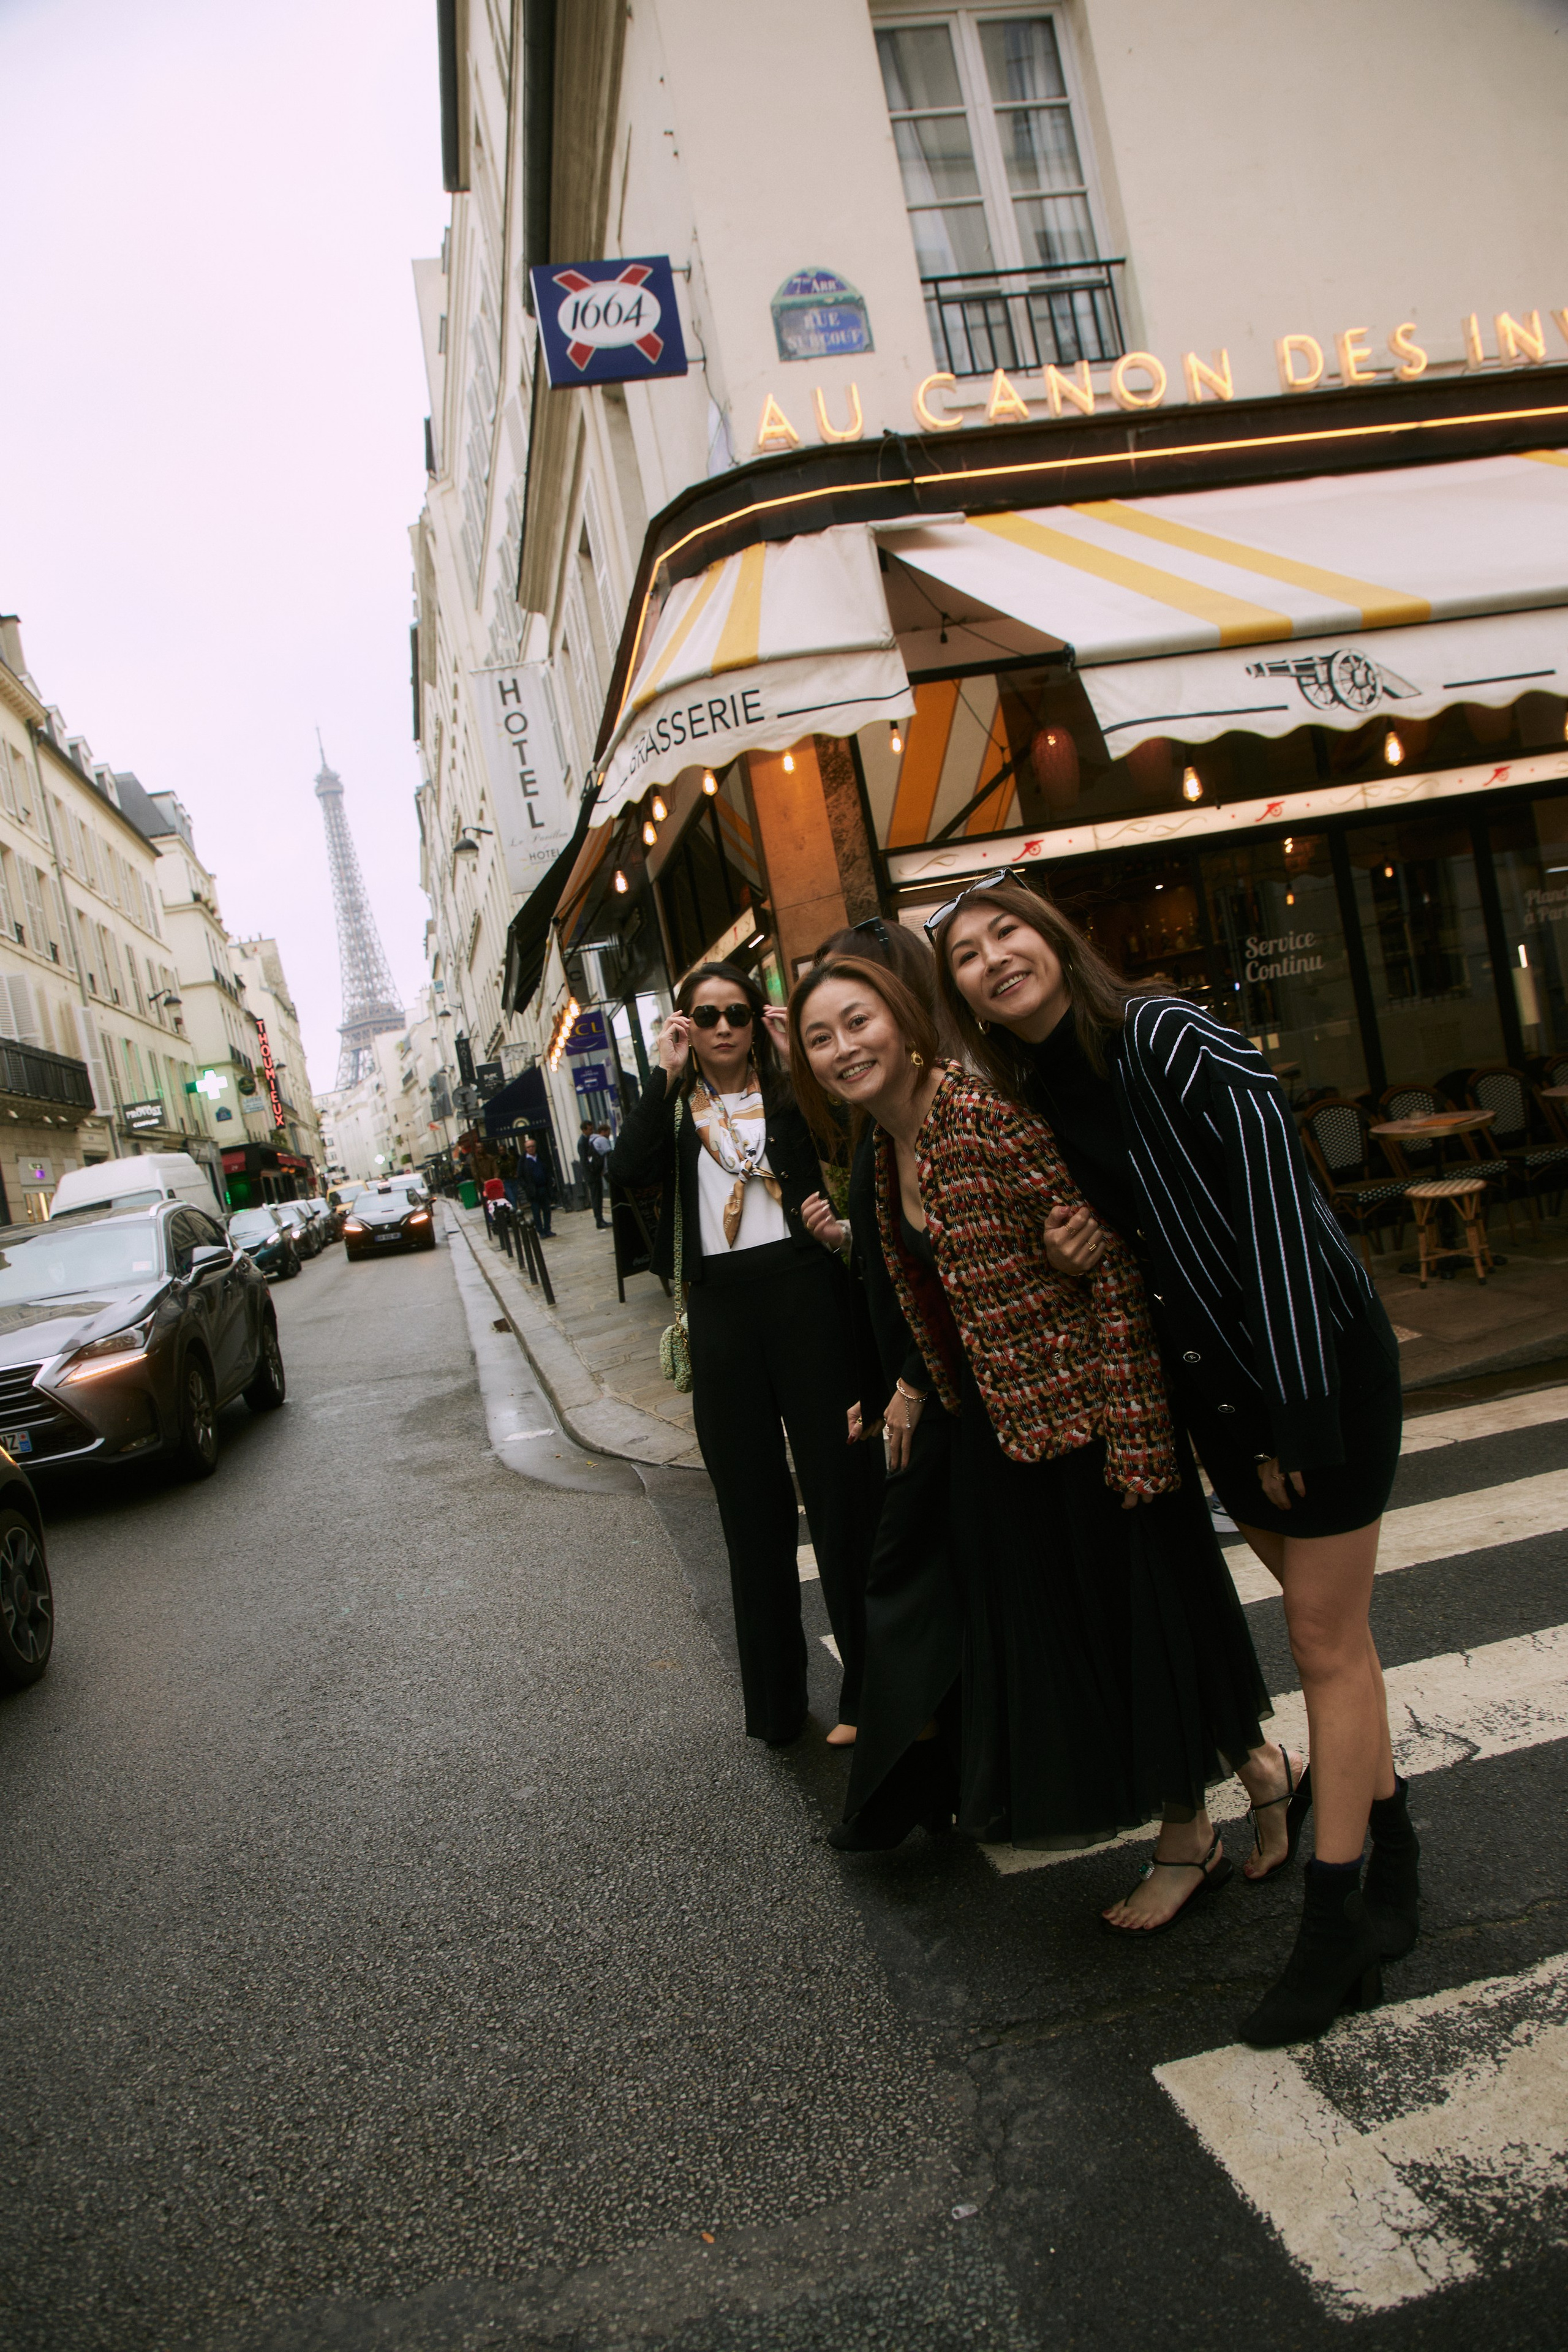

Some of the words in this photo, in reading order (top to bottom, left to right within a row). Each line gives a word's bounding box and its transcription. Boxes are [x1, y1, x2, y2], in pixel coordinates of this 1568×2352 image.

[570, 292, 650, 333] 1664
[804, 307, 841, 330] RUE
[753, 381, 865, 453] AU
[911, 347, 1235, 433] CANON
[1274, 321, 1429, 393] DES
[497, 677, 545, 829] HOTEL
[628, 688, 766, 775] BRASSERIE
[1244, 929, 1317, 960] Service
[1245, 954, 1327, 984] Continu
[255, 1020, 285, 1126] THOUMIEUX
